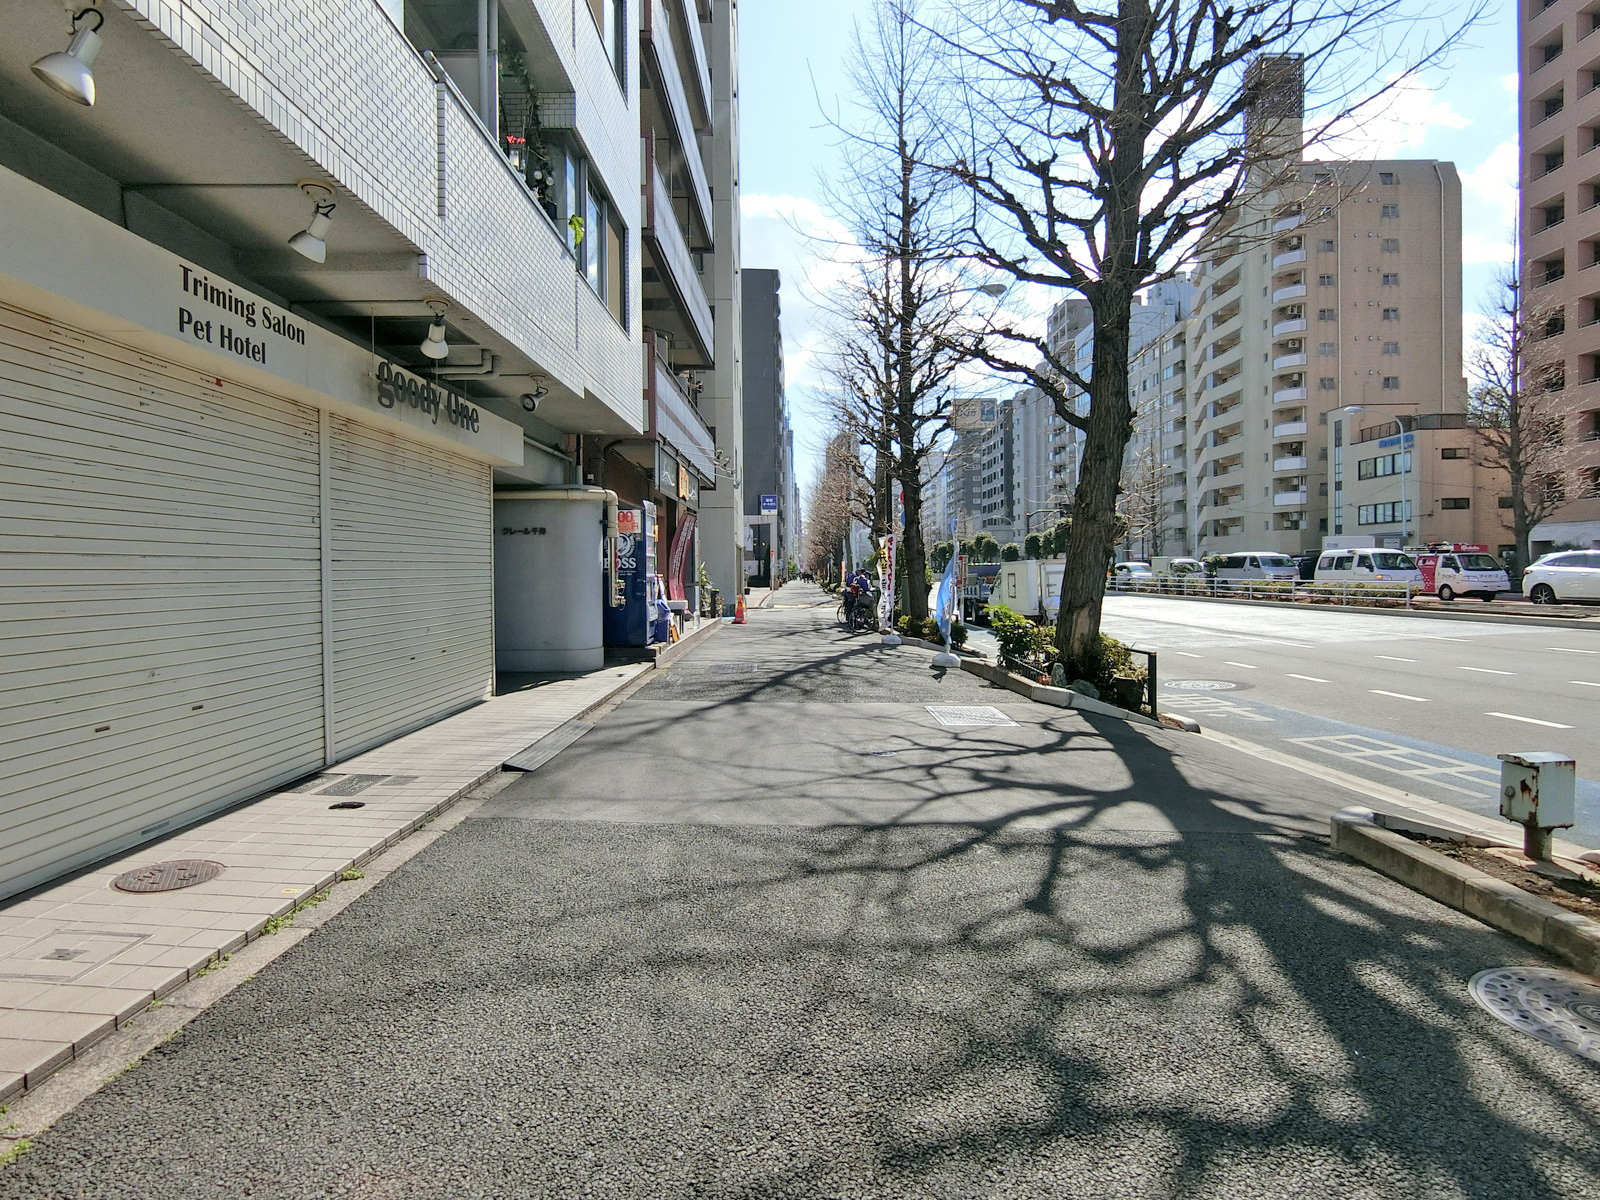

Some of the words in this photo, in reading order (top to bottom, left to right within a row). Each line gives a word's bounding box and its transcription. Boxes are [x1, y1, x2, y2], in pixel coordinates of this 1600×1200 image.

[179, 264, 256, 328] Triming
[262, 306, 305, 345] Salon
[179, 307, 213, 344] Pet
[220, 324, 266, 364] Hotel
[377, 361, 442, 425] goody
[446, 392, 480, 434] One
